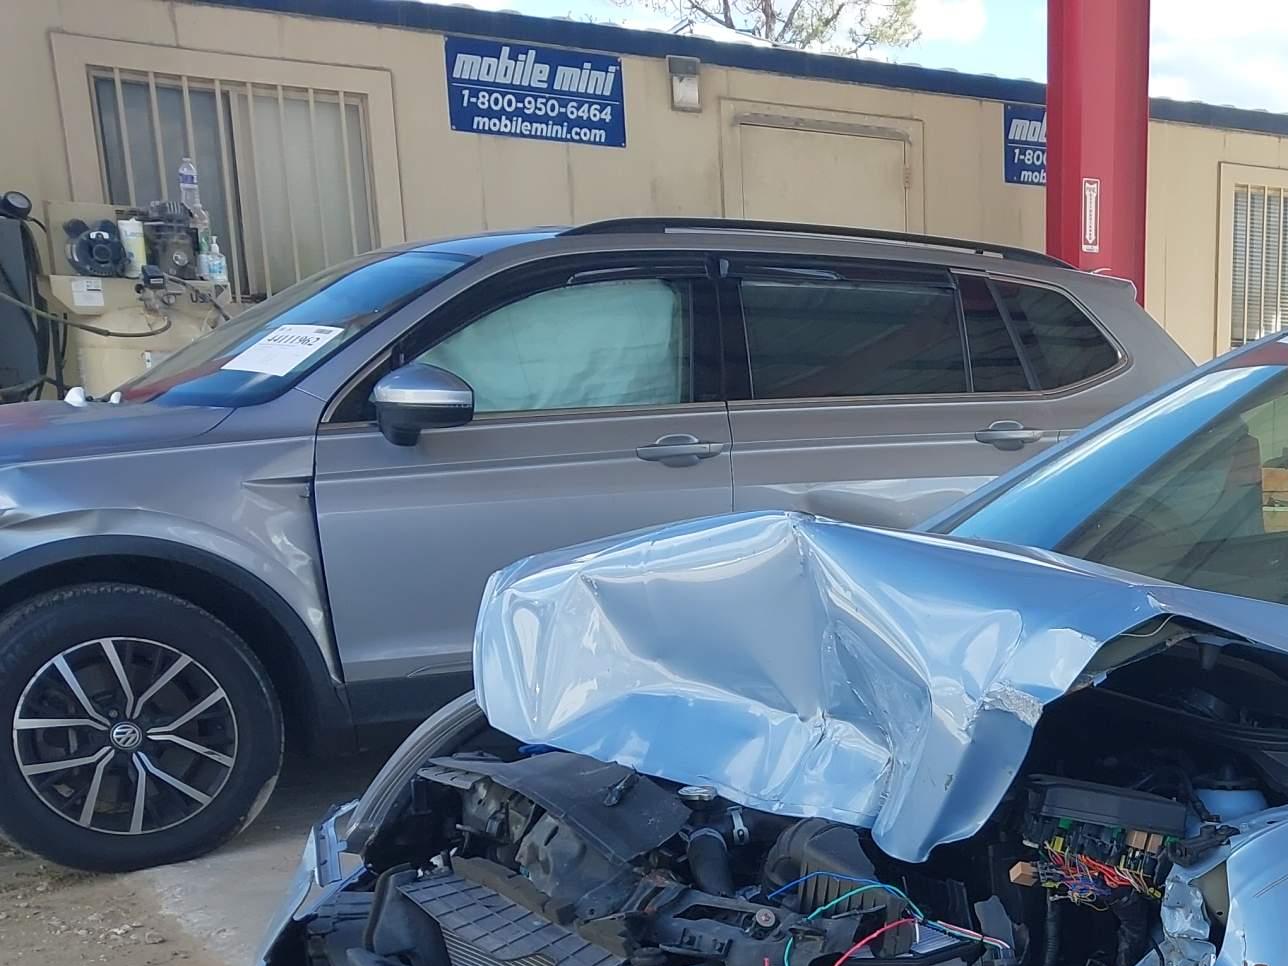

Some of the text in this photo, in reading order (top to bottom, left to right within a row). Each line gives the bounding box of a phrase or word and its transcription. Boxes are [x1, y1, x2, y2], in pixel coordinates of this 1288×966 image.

[452, 46, 616, 96] mobile mini
[461, 89, 612, 123] 1-800-950-6464
[472, 115, 606, 142] mobilemini.com
